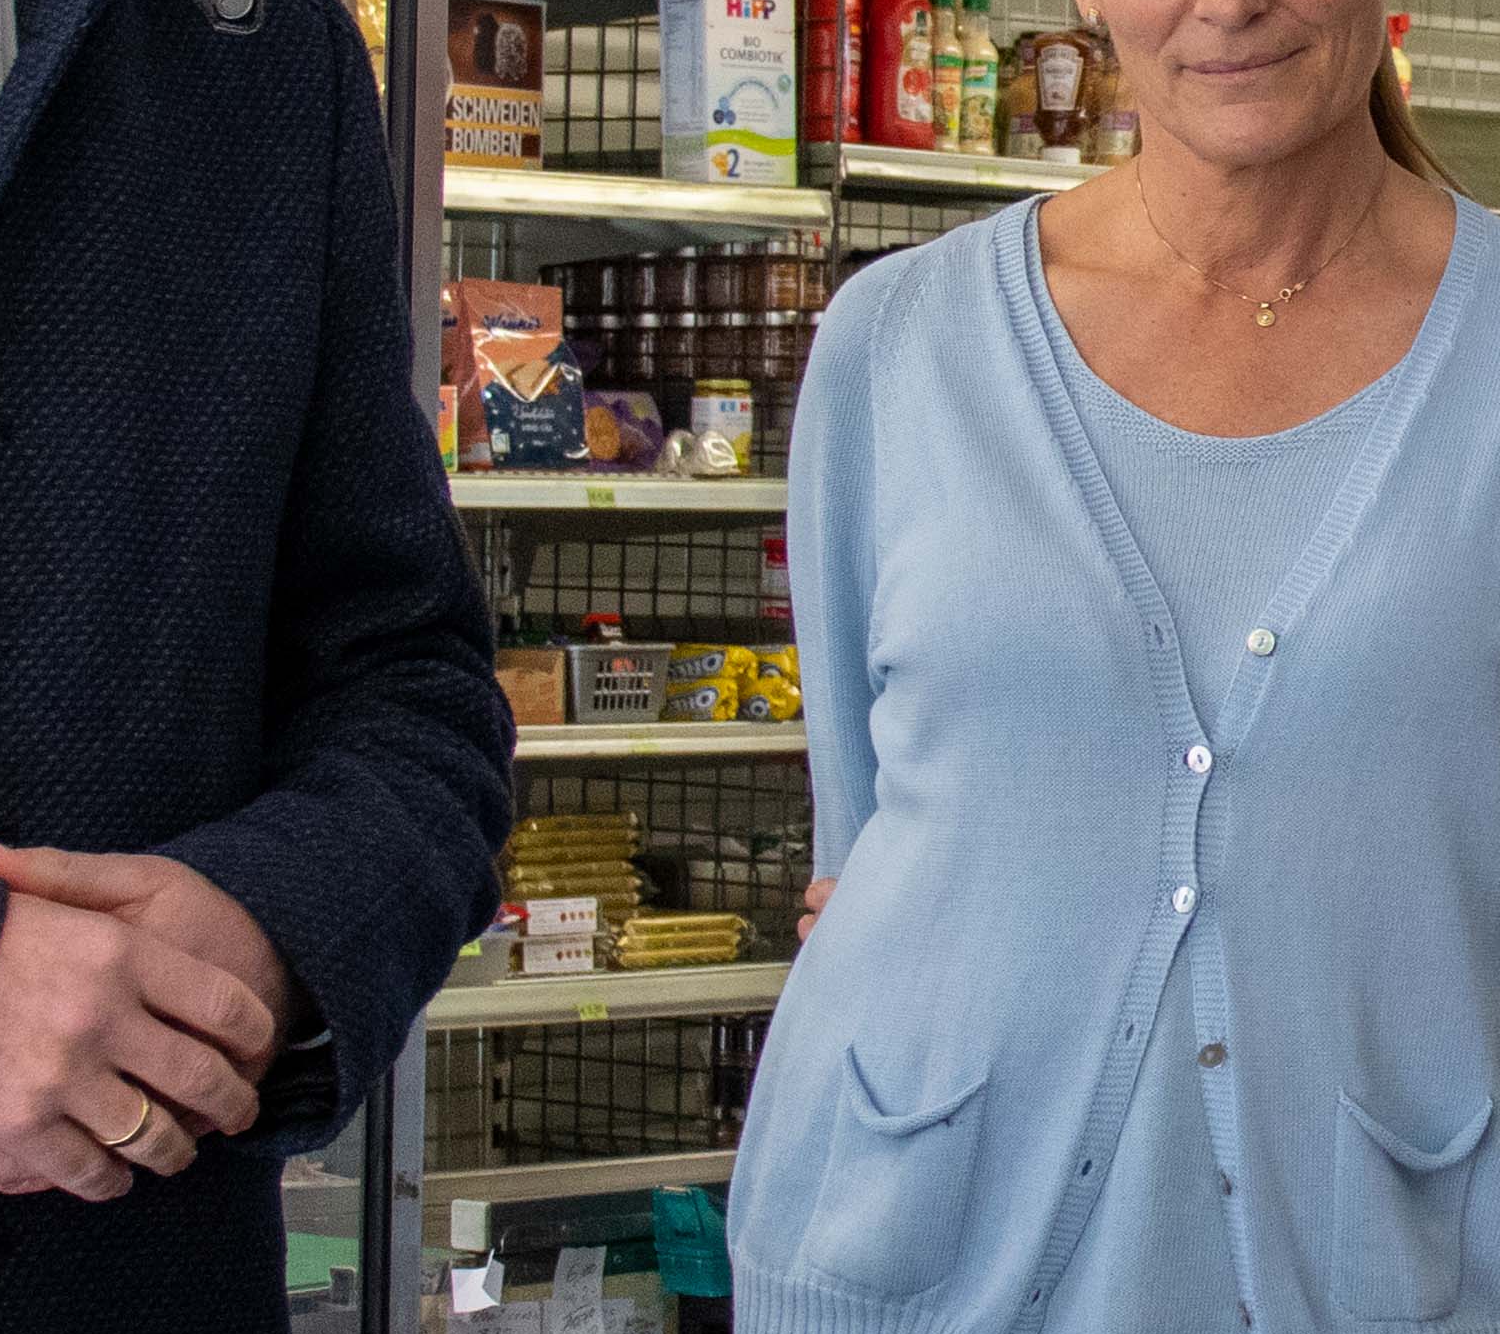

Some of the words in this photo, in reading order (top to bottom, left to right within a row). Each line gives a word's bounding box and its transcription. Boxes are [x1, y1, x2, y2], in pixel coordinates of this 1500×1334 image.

[451, 95, 541, 129] SCHWEDEN
[451, 126, 522, 158] BOMBEN
[726, 147, 741, 178] 2
